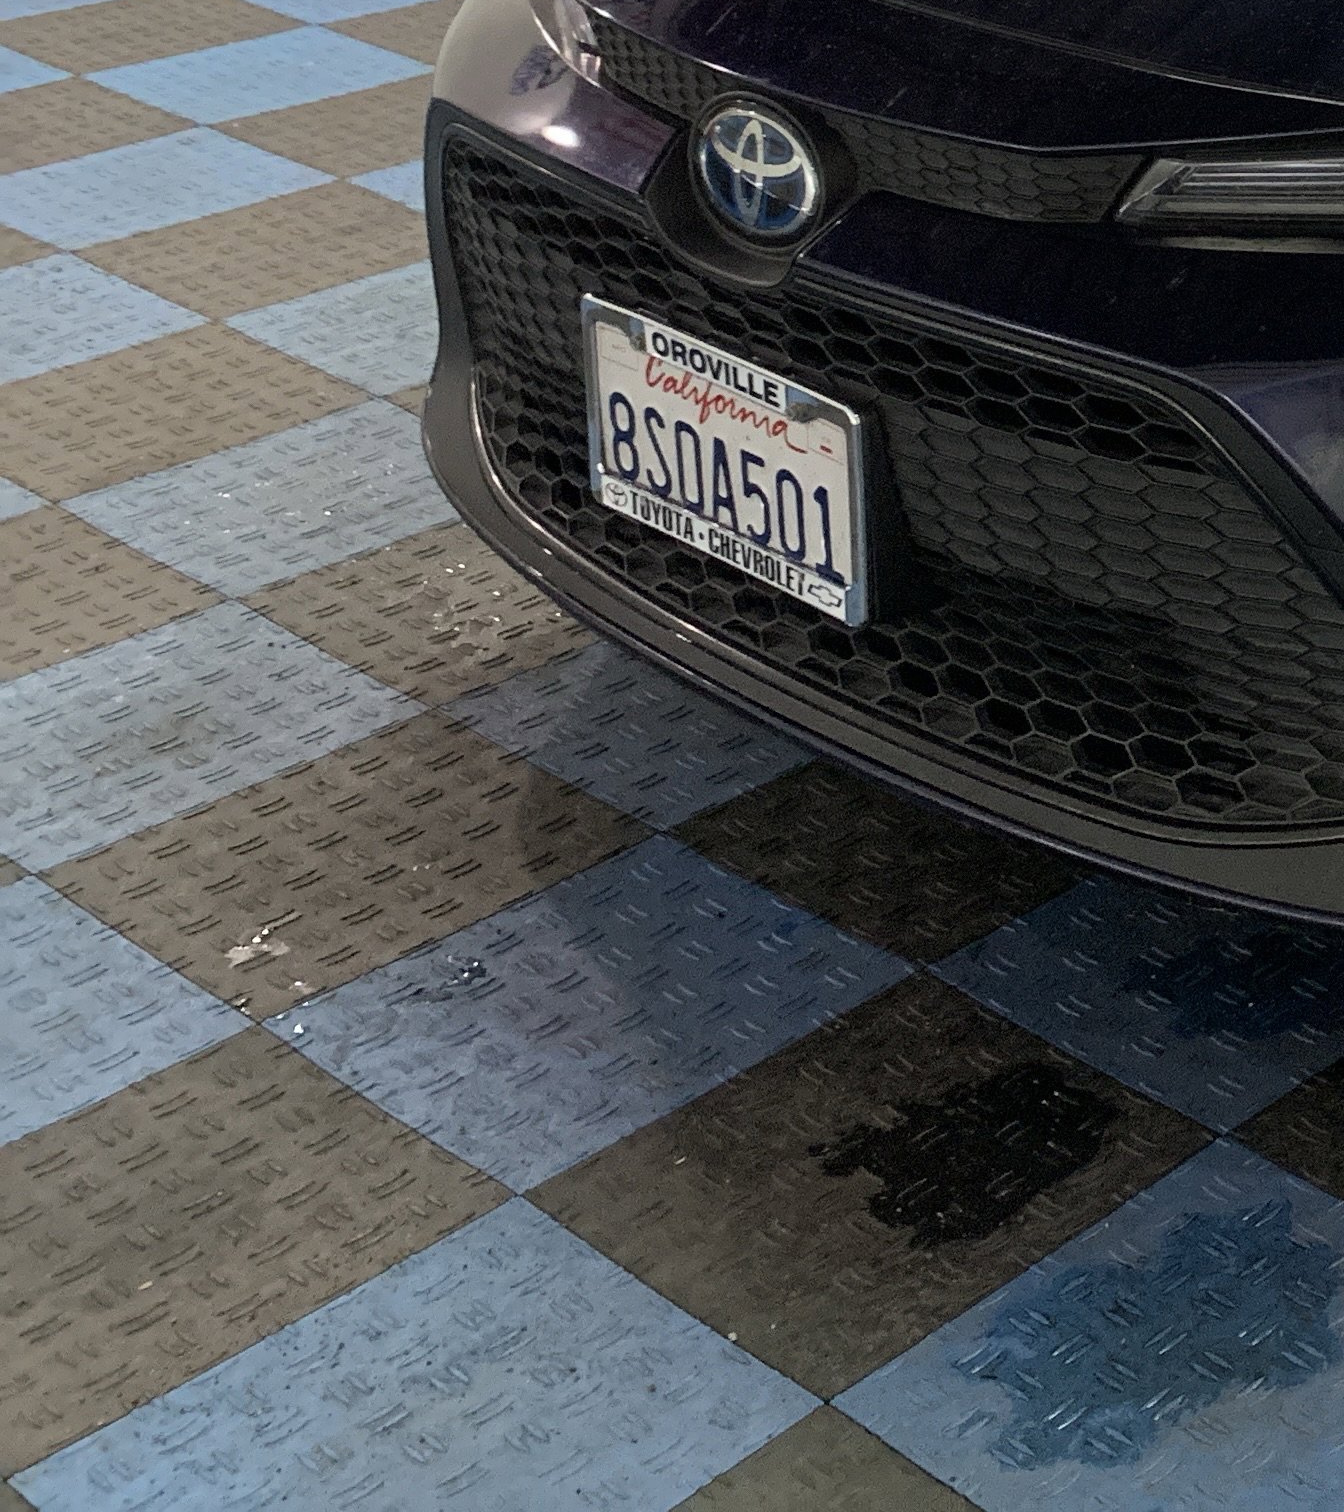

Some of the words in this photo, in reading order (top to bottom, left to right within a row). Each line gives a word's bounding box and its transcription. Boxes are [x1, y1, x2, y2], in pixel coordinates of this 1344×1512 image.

[645, 356, 807, 455] California
[652, 332, 781, 408] OROVILLE
[629, 490, 695, 543] TOYOTA
[708, 528, 806, 596] CHEVROLET
